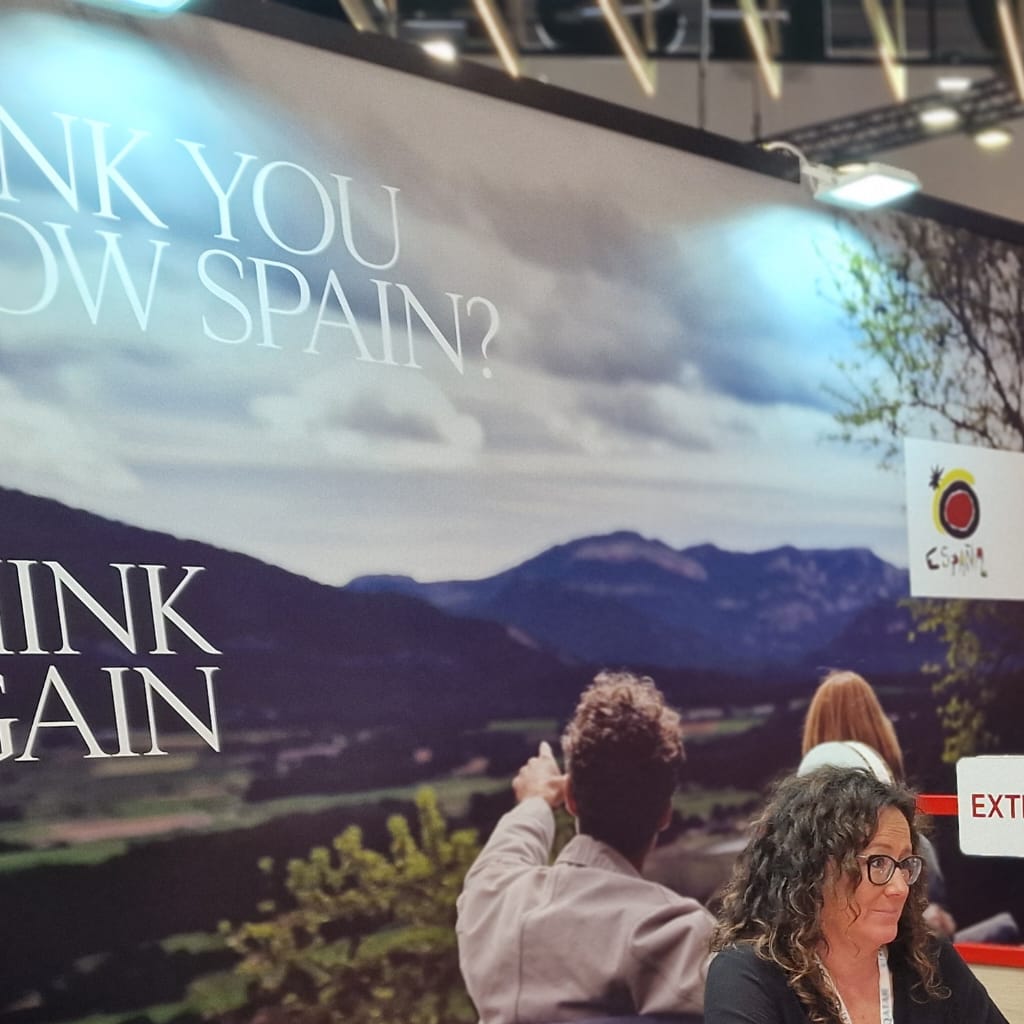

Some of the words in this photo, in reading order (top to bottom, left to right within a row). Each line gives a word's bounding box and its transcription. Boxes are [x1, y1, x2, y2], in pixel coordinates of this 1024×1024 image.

[175, 139, 402, 271] YOU
[199, 249, 501, 379] SPAIN?
[0, 560, 223, 655] INK
[0, 665, 221, 762] AIN
